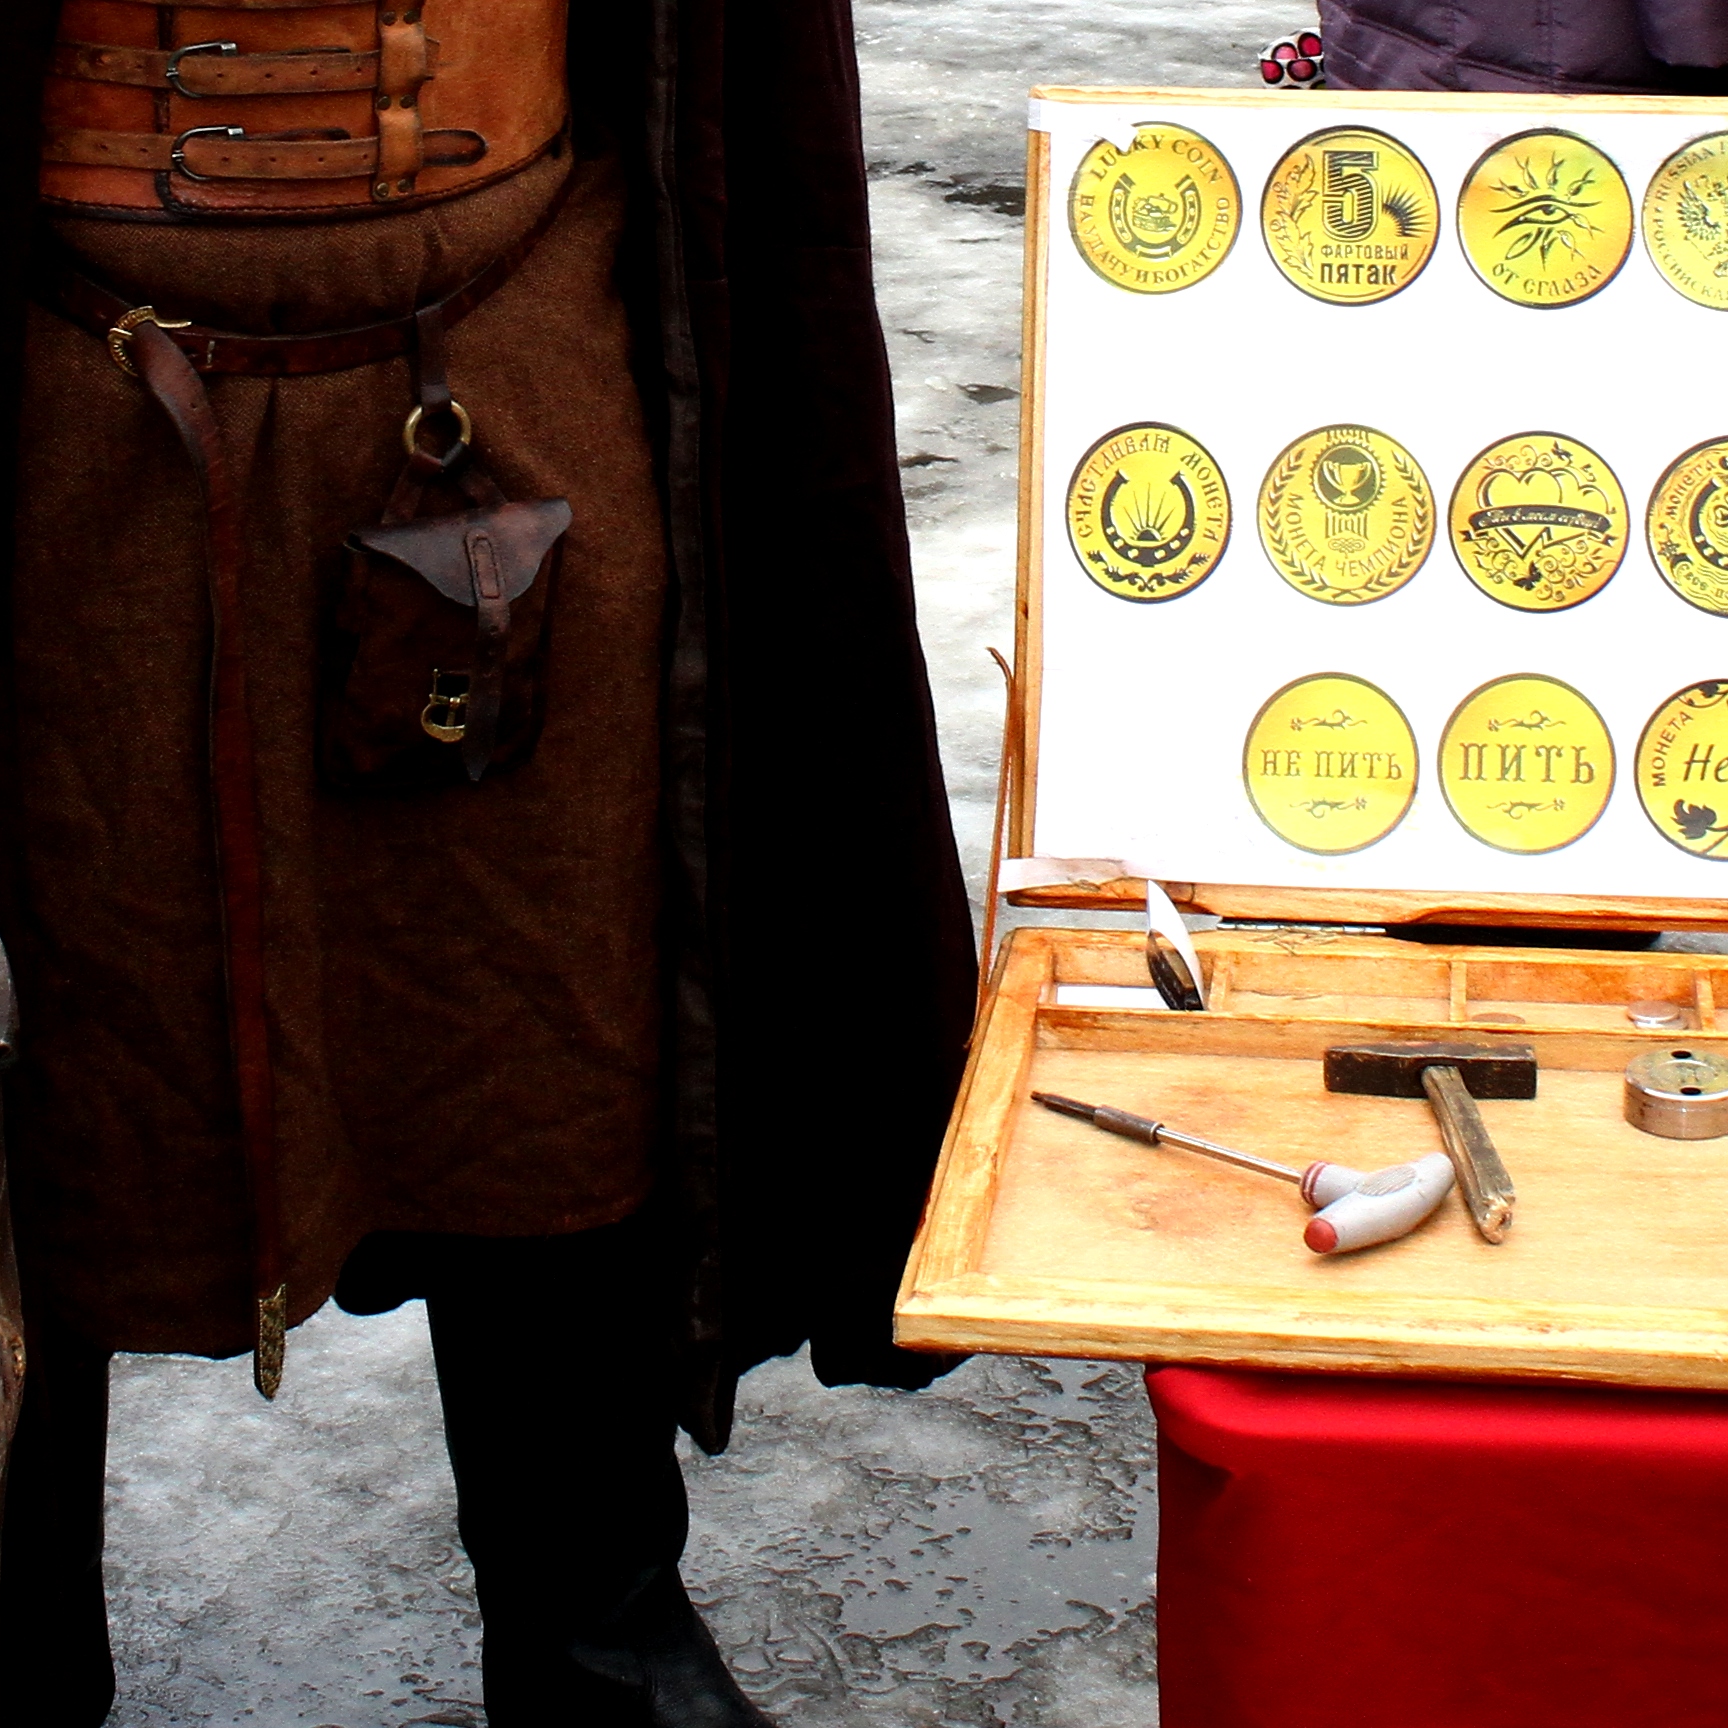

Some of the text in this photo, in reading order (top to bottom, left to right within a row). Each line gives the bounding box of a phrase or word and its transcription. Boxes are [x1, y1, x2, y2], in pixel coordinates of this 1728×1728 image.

[1172, 139, 1223, 184] COIN
[1655, 146, 1714, 203] RUSSIAN
[1322, 150, 1379, 242] 5
[1321, 244, 1409, 260] ФАРТОВЫЙ
[1492, 263, 1602, 297] ОТ СГЛАЗА
[1180, 451, 1224, 542] МОНЕТА
[1285, 493, 1408, 577] МОНЕТА ЧЕМПИОНА
[1260, 749, 1402, 780] НЕ ПИТЬ
[1459, 743, 1595, 784] ПИТЬ
[1652, 711, 1693, 787] МОНЕТА
